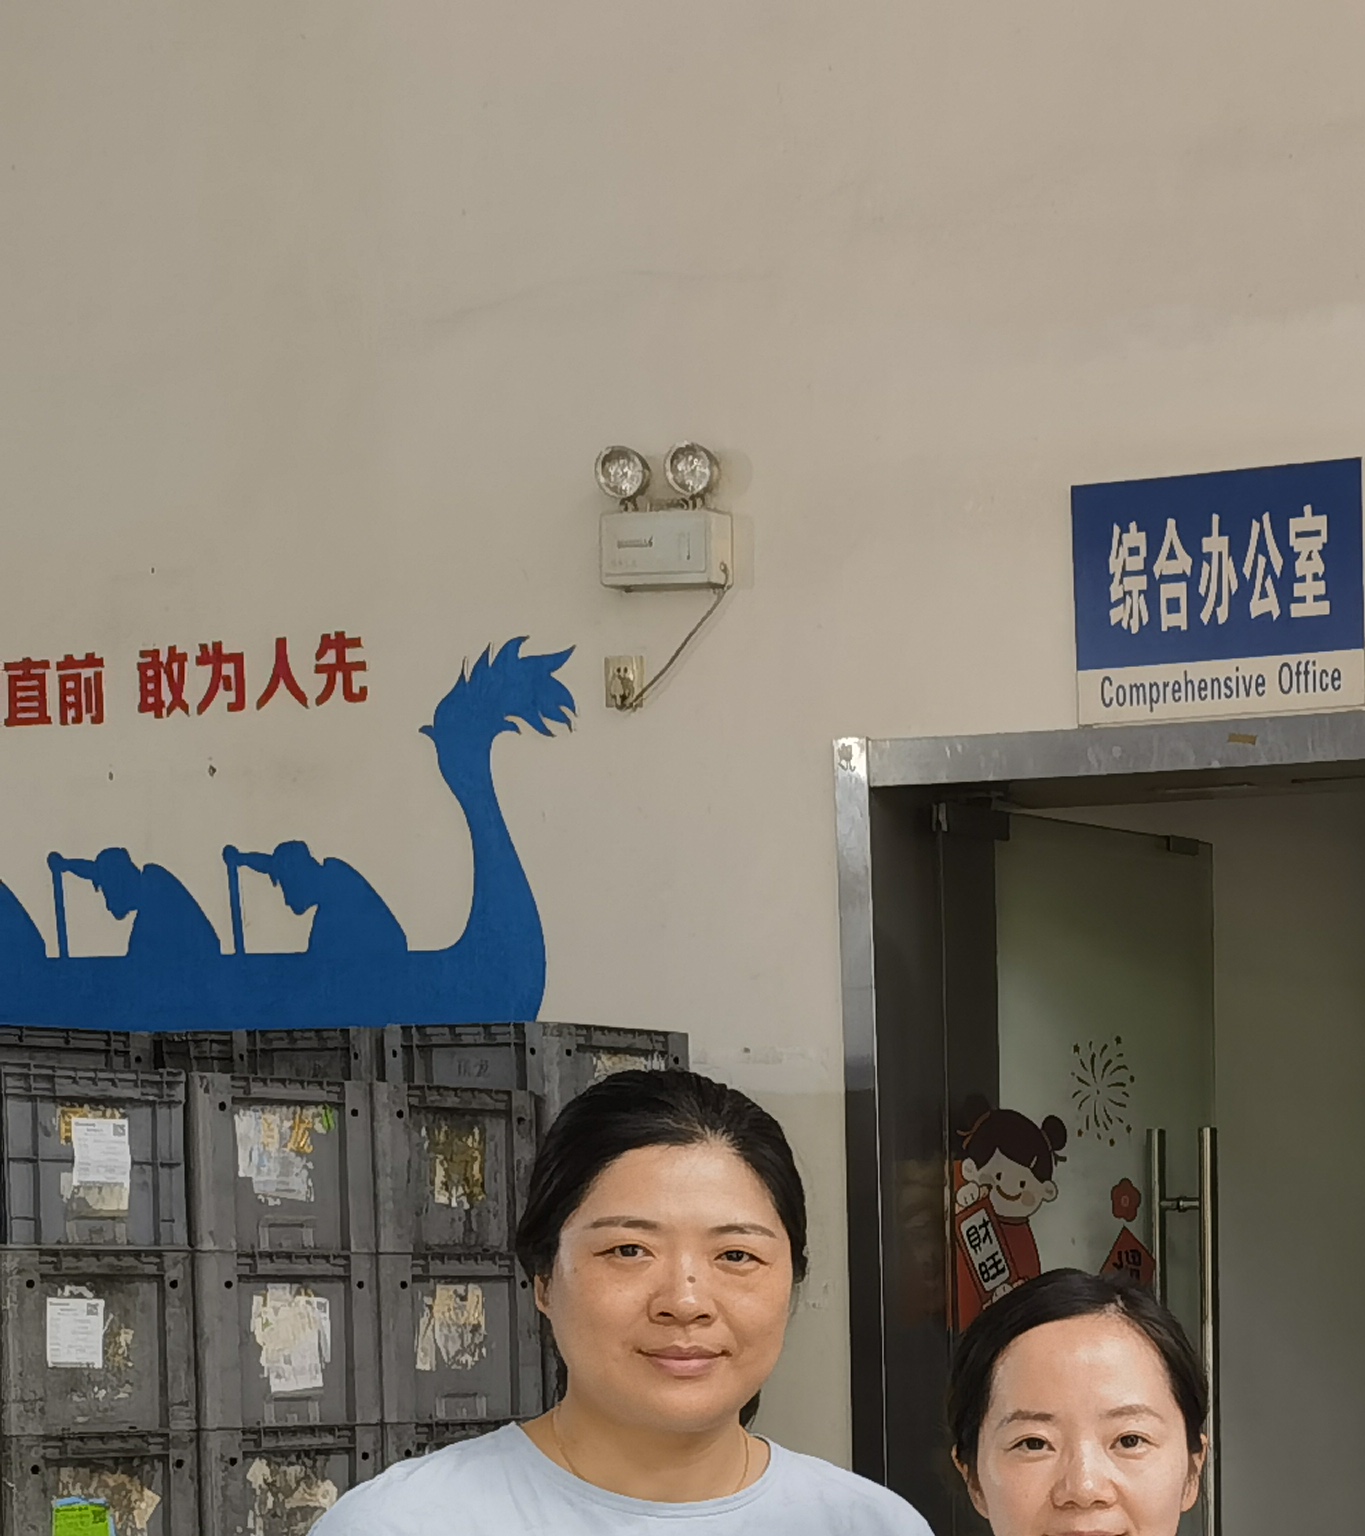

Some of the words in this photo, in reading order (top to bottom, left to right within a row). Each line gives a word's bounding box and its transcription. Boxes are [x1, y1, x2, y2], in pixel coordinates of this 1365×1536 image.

[1108, 503, 1331, 635] 综合办公室
[3, 652, 105, 727] 直前
[137, 631, 368, 719] 敢为人先
[1100, 667, 1266, 712] Comprehensive
[1278, 660, 1342, 694] Office
